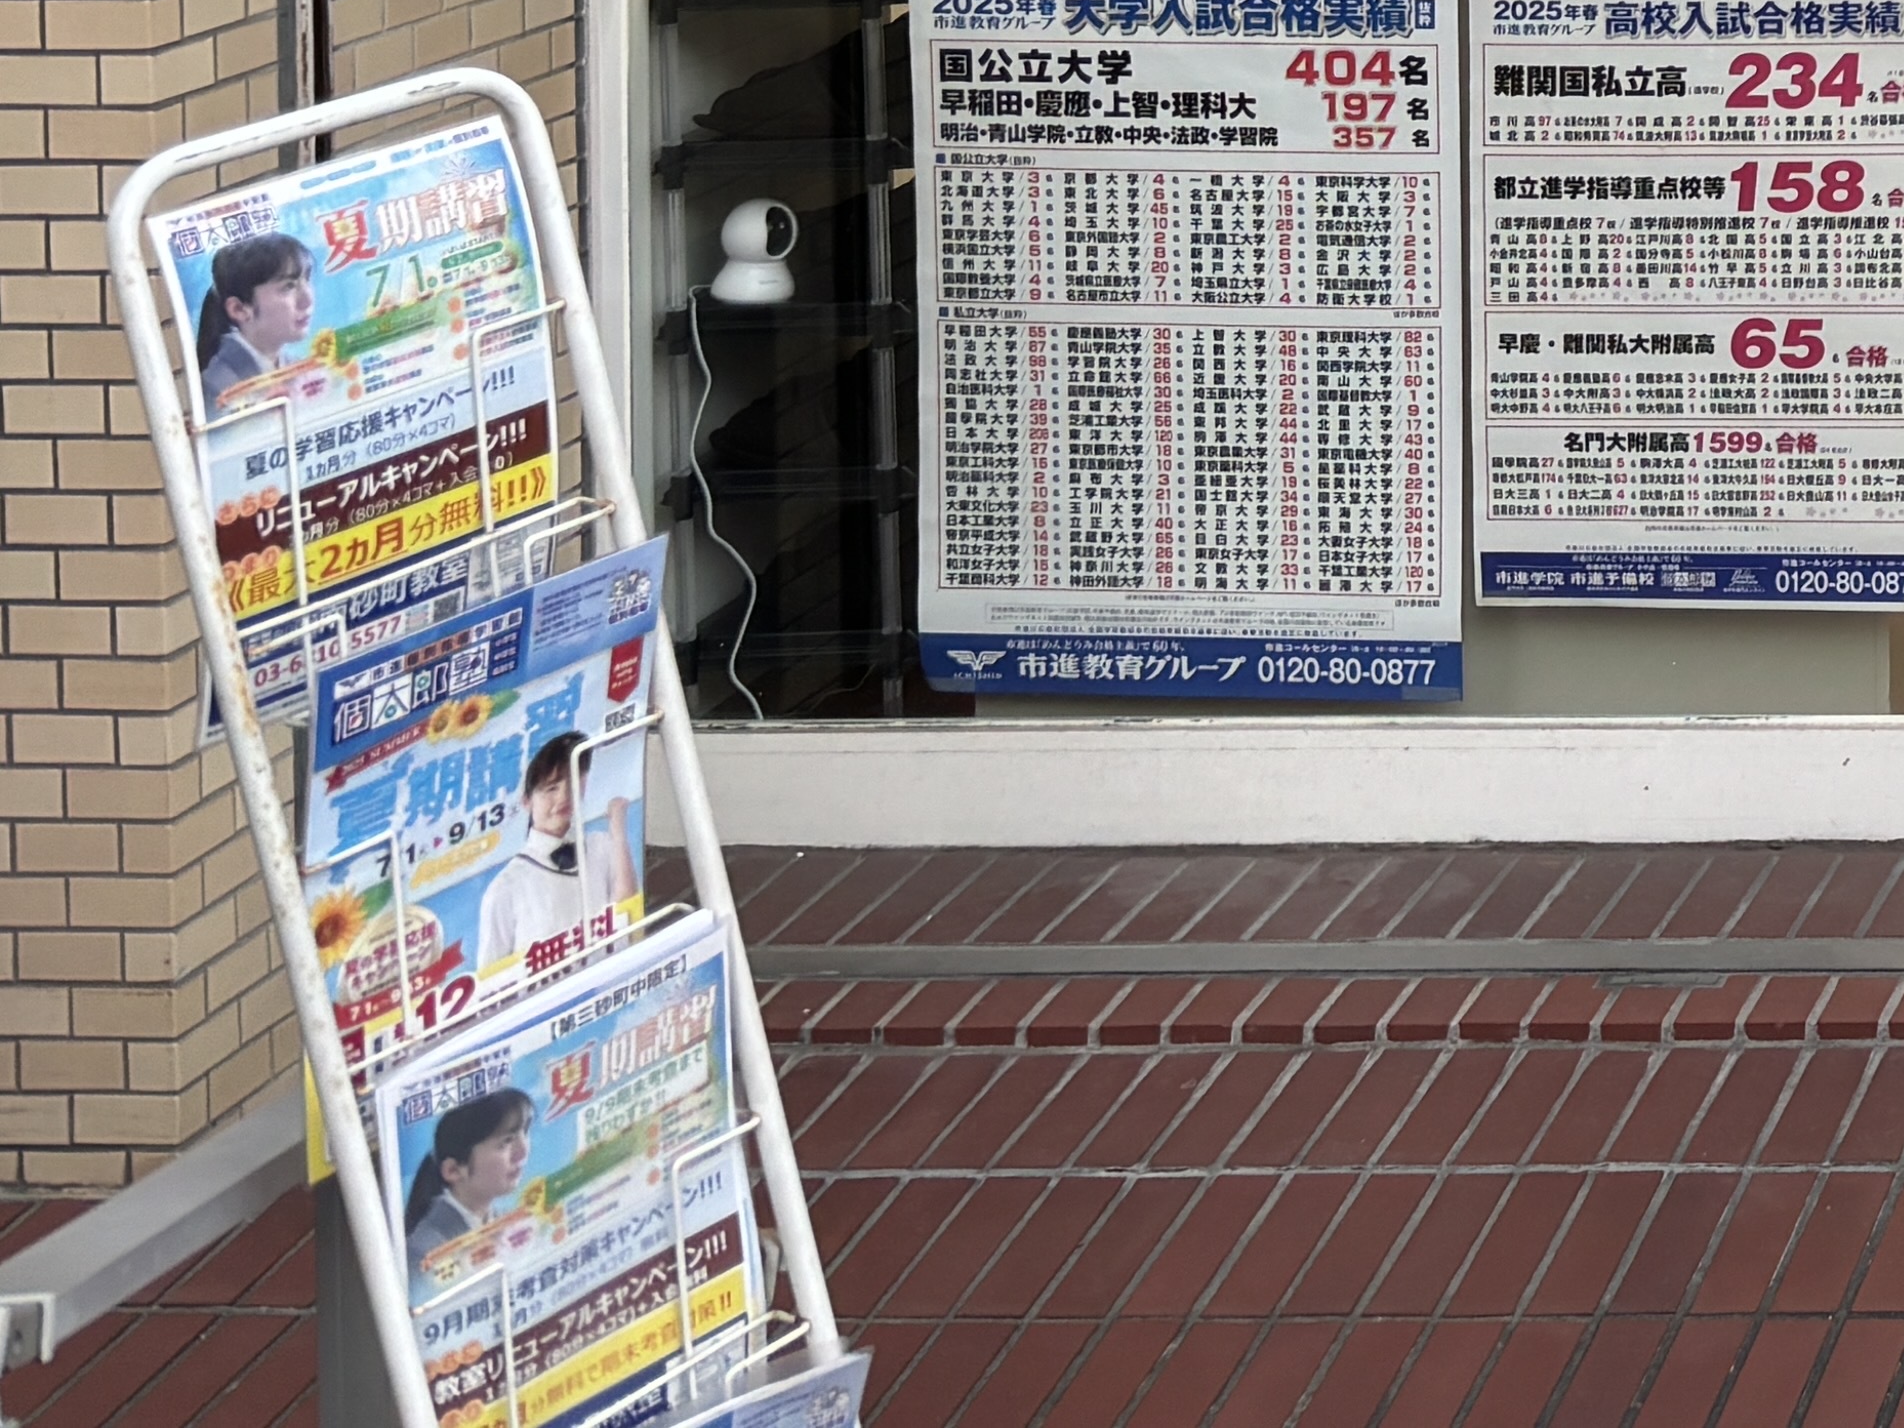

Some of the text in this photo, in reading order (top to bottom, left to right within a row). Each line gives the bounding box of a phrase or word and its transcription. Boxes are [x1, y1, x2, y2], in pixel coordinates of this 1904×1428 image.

[1604, 1, 1901, 38] 高校入試合格実績
[939, 49, 1133, 84] 国公立大学
[1494, 65, 1688, 98] 難関国私立高
[1017, 653, 1436, 686] 市進教育グループ 0120-80-0877
[449, 802, 505, 844] 9/13
